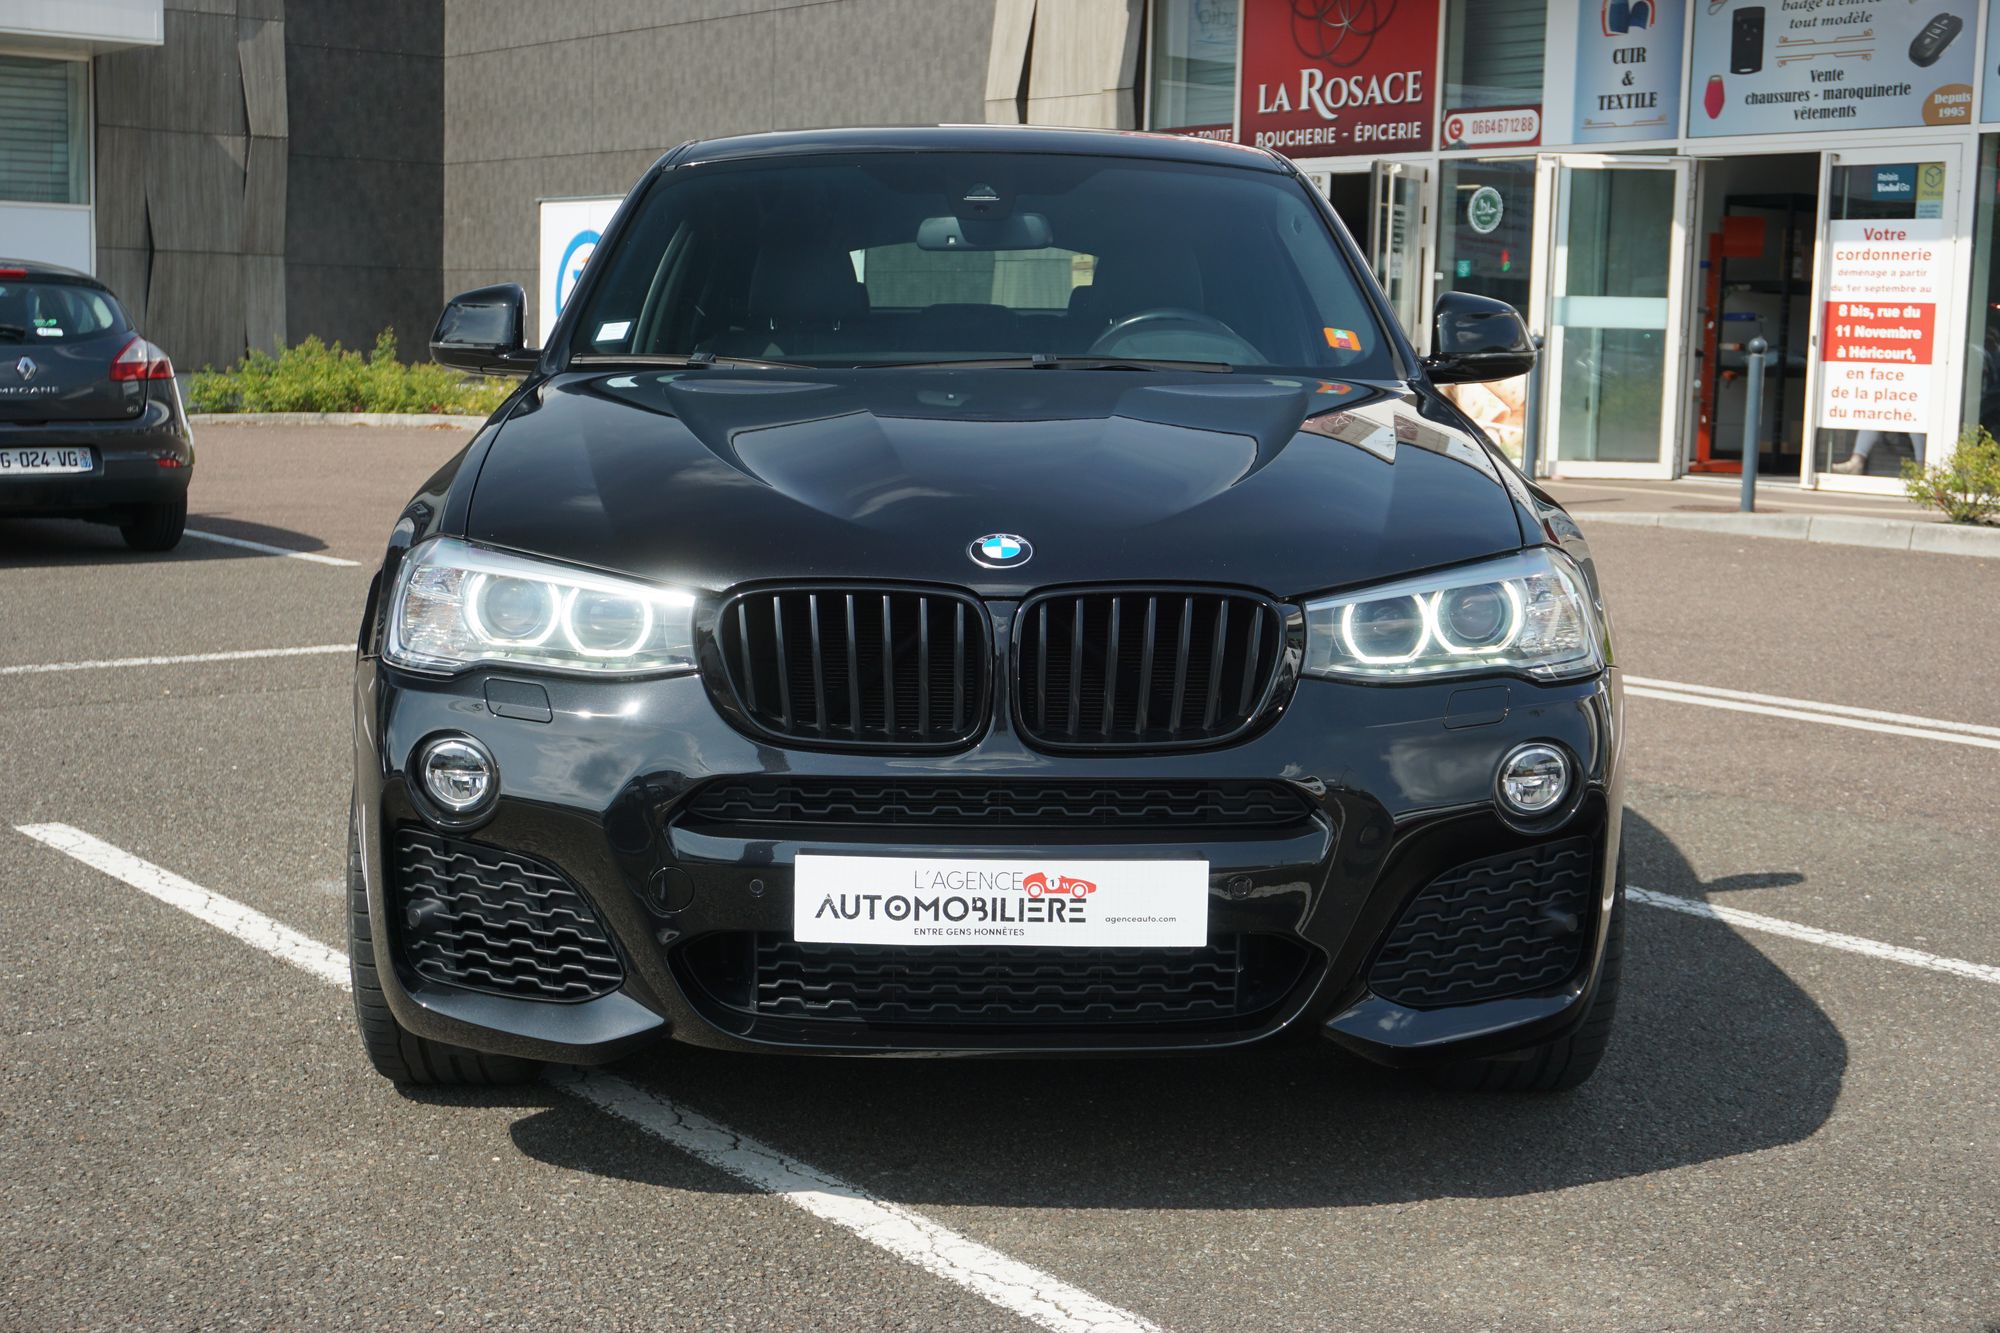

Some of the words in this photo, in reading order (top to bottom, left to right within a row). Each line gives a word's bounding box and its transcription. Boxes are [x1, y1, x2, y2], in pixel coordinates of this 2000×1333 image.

[1789, 16, 1818, 29] tout
[1821, 10, 1873, 26] modèle
[1613, 46, 1647, 65] CUIR
[1622, 70, 1635, 87] &
[1810, 69, 1844, 83] Vente
[1257, 82, 1292, 114] LA
[1298, 68, 1423, 120] ROSACE
[1597, 91, 1658, 111] TEXTILE
[1744, 89, 1811, 105] chaussures
[1823, 82, 1912, 100] maroquinerie
[1934, 93, 1972, 105] Depuis
[1793, 105, 1857, 120] vêtements
[1938, 106, 1966, 118] 1995
[1255, 127, 1337, 148] BOUCHERIE
[1354, 121, 1422, 142] ÉPICERIE
[1863, 228, 1906, 241] Votre
[1836, 248, 1932, 261] cordonnerie
[1899, 268, 1928, 278] partir
[1864, 284, 1918, 294] septembre
[1838, 304, 1848, 318] 8
[1850, 304, 1875, 320] bis,
[1877, 307, 1901, 318] rue
[1903, 305, 1921, 318] du
[1835, 324, 1851, 338] 11
[1854, 325, 1922, 340] Novembre
[1846, 369, 1865, 380] en
[1870, 367, 1905, 381] face
[1831, 386, 1849, 399] de
[1855, 386, 1868, 399] la
[1874, 387, 1918, 403] place
[1829, 406, 1847, 418] du
[914, 870, 1023, 891] L'AGENCE
[1105, 915, 1177, 925] agenceauto.com
[914, 928, 943, 936] ENTRE
[946, 928, 972, 936] GENS
